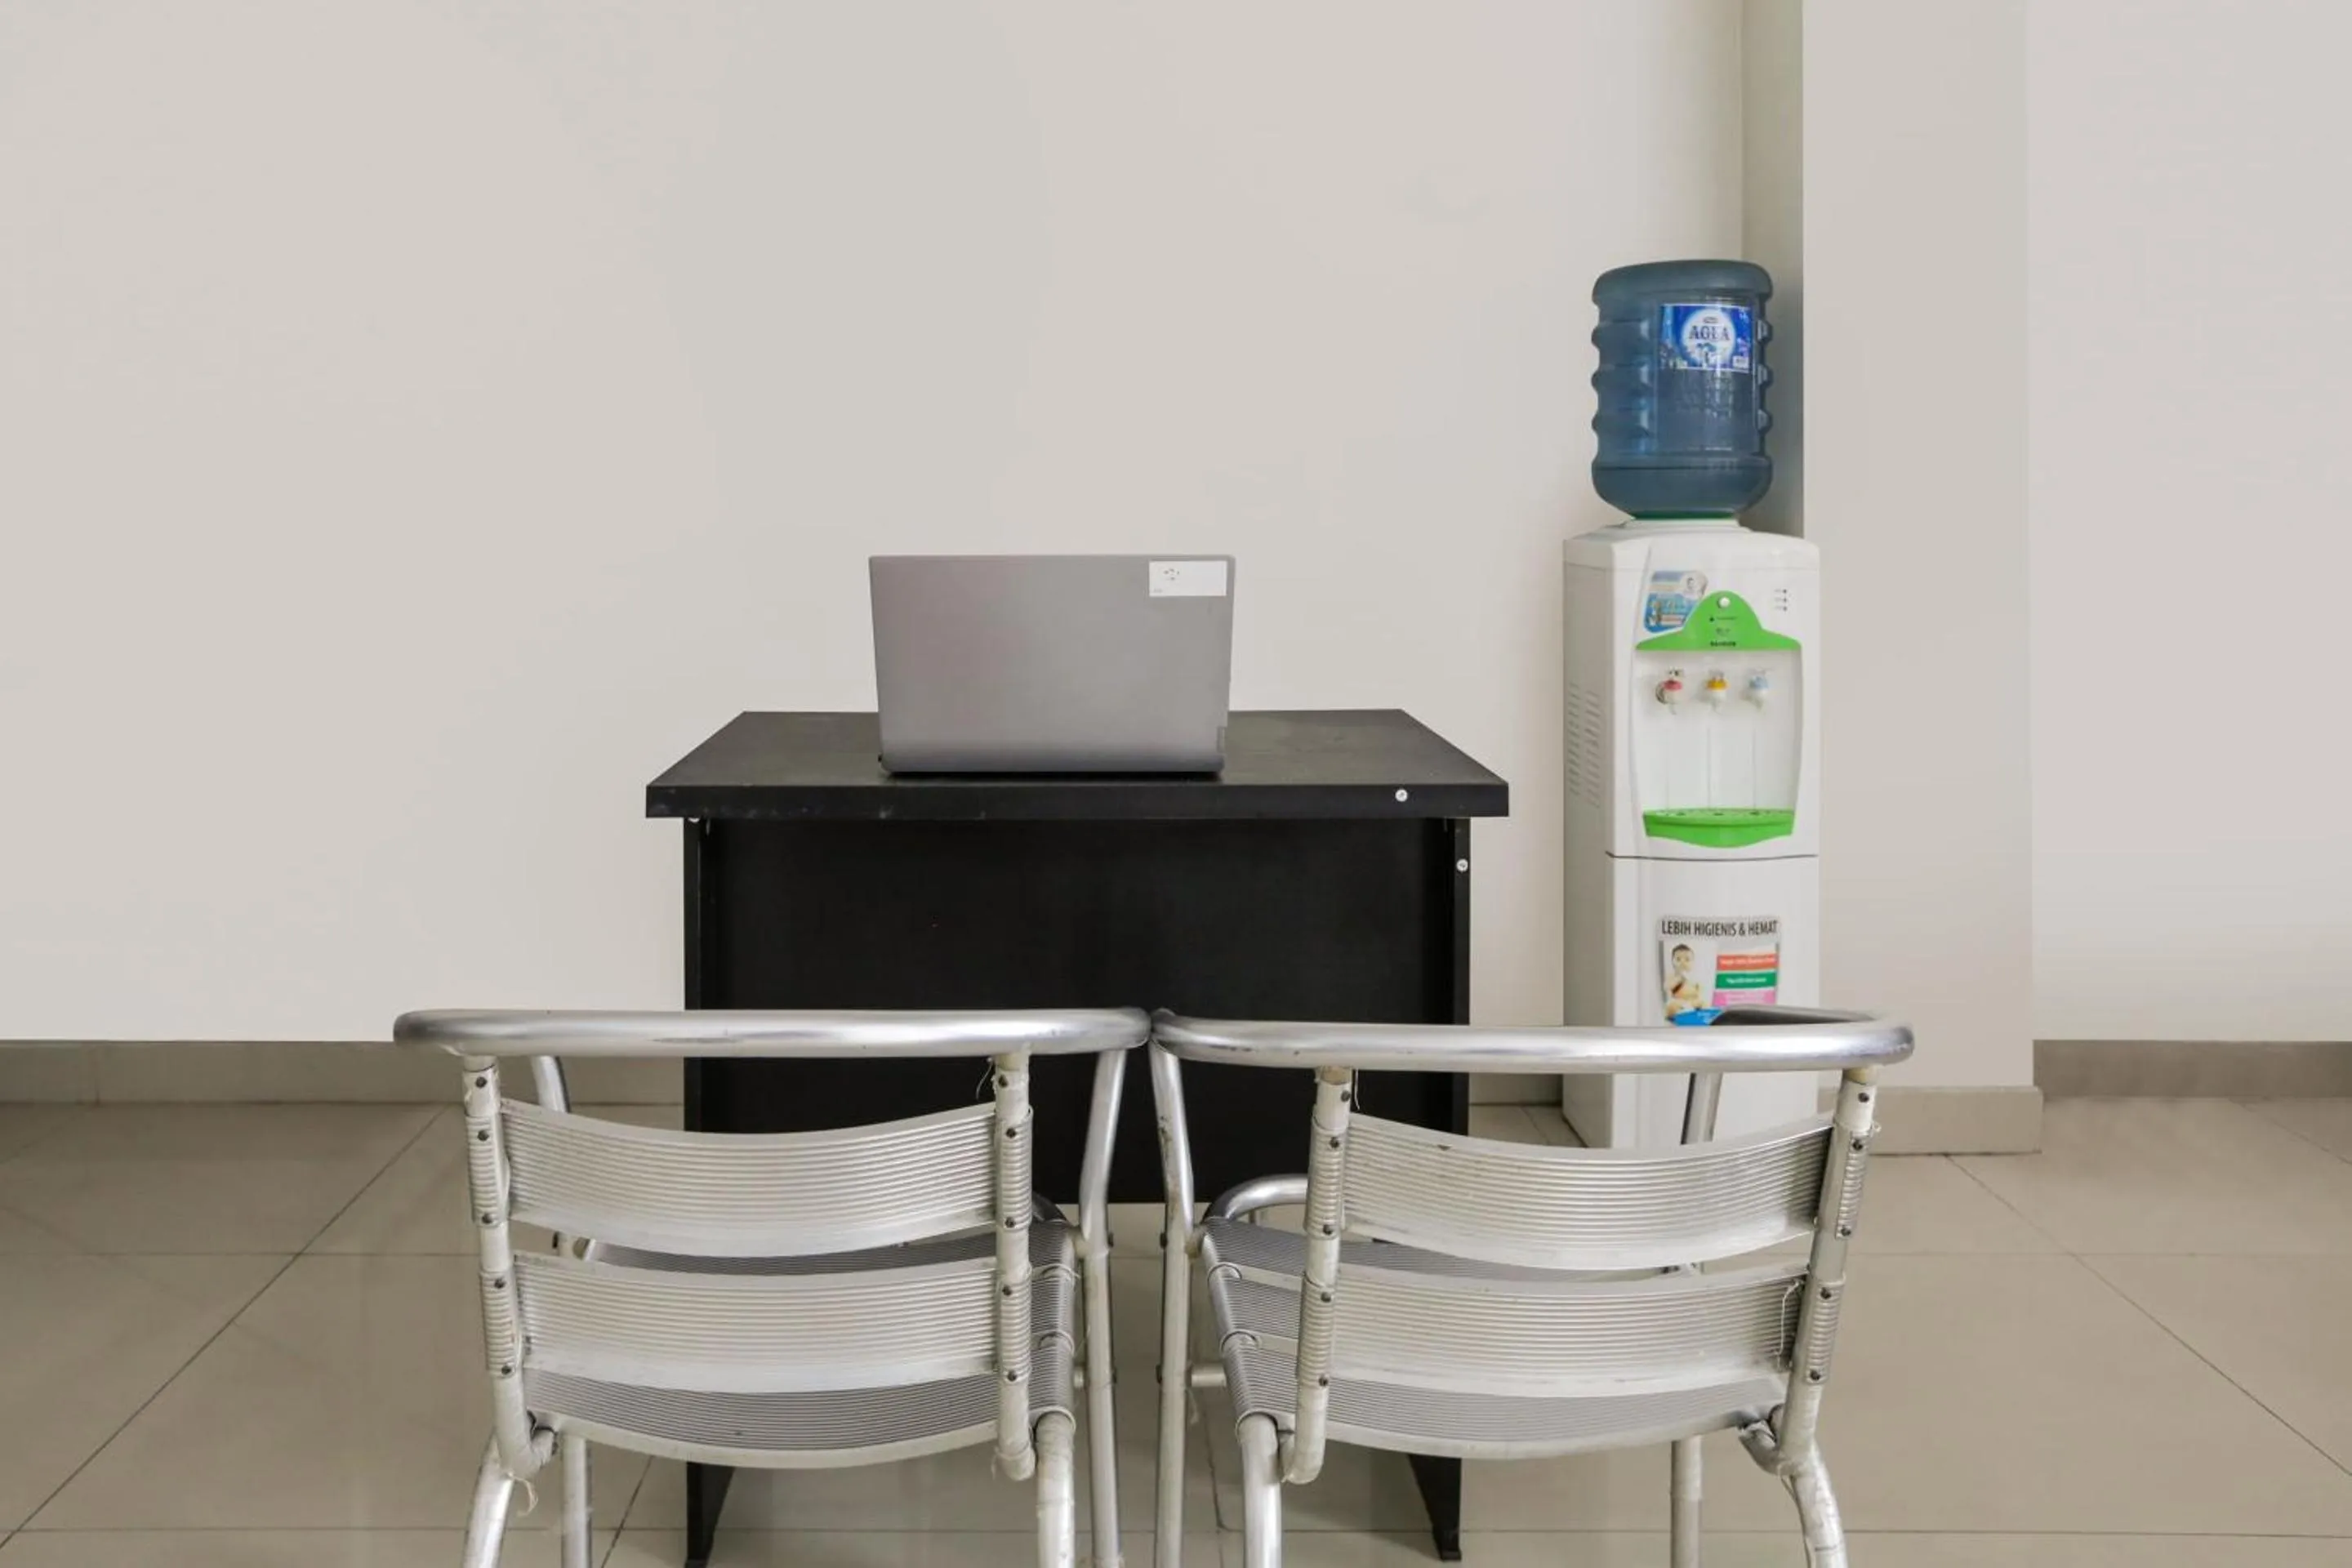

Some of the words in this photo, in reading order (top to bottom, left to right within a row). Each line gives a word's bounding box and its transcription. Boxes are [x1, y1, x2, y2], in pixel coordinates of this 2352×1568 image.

[1661, 920, 1691, 935] LEBIH
[1694, 921, 1737, 936] HIGIENIS
[1739, 922, 1746, 936] &
[1748, 920, 1778, 935] HEMAT
